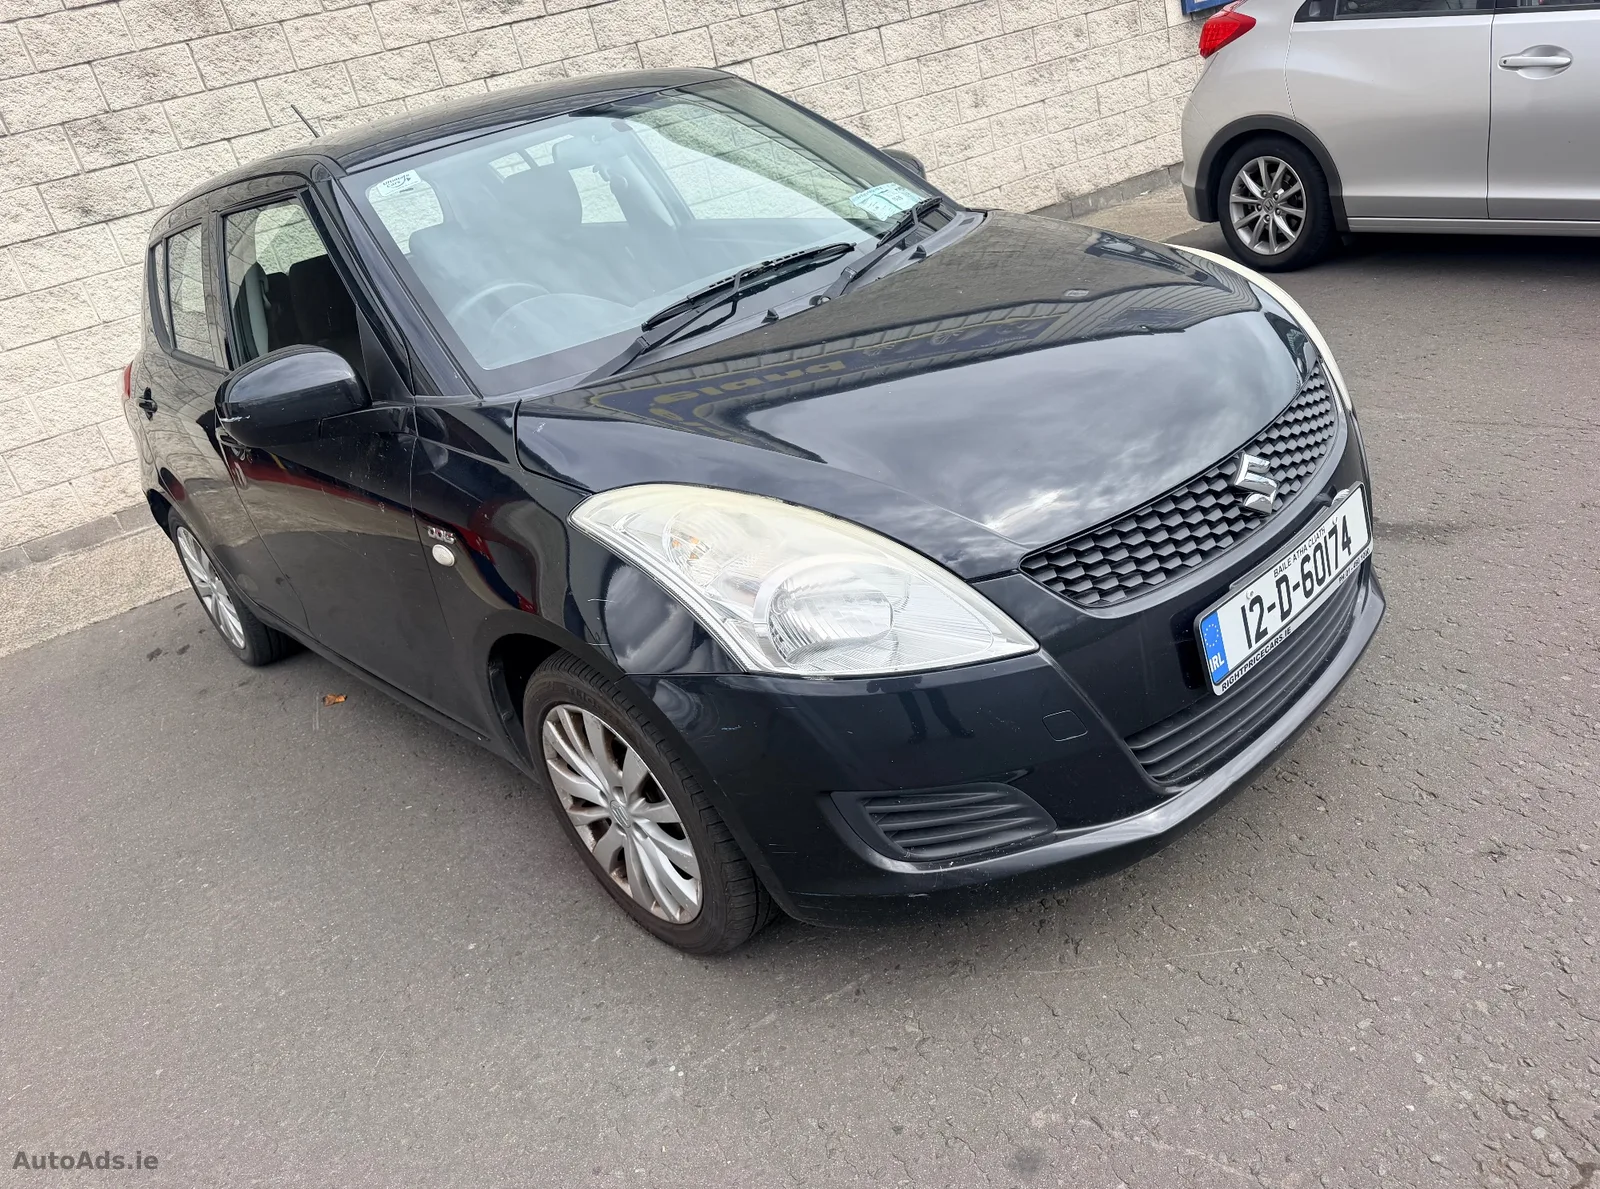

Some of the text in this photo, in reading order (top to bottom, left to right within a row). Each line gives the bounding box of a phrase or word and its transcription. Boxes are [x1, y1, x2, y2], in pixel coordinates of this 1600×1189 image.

[1241, 514, 1352, 650] 12-D-60174
[1273, 557, 1292, 578] BAILE
[1208, 653, 1226, 672] IRL
[1221, 625, 1293, 692] RIGHTPRICECARS.IE
